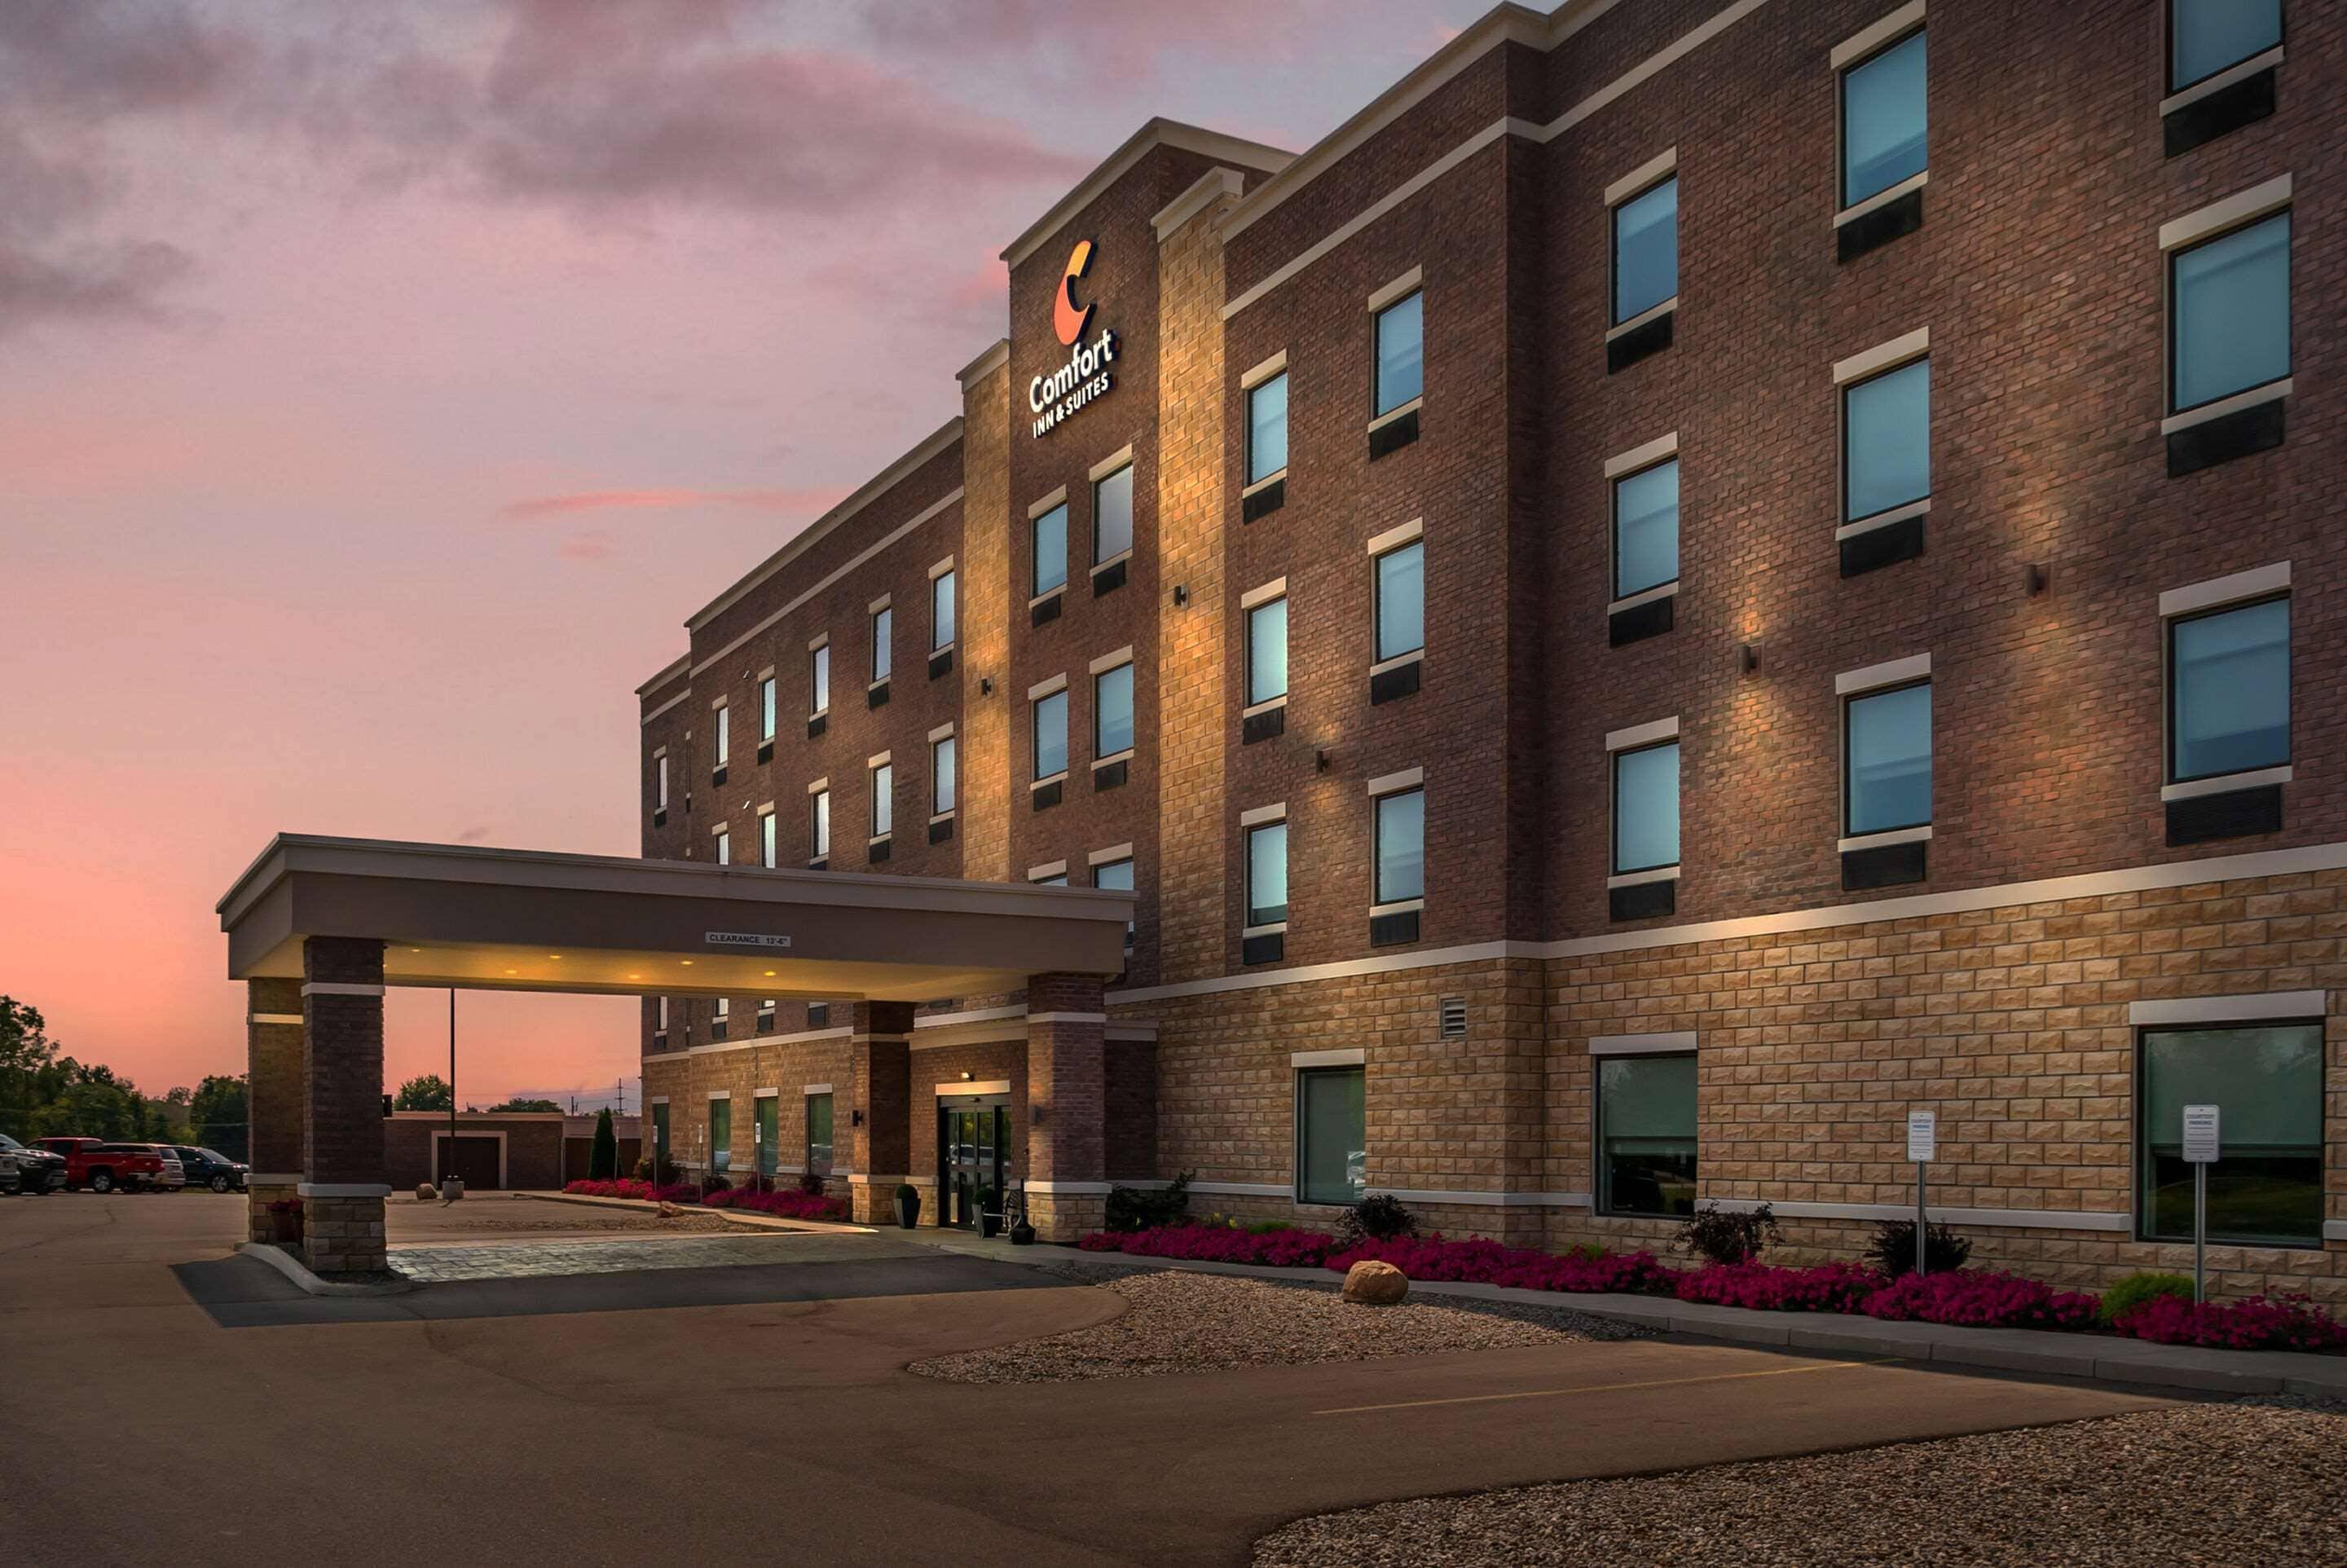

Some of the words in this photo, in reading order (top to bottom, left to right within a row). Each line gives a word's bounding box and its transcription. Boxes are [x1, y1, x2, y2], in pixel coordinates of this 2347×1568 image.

[1029, 328, 1113, 413] Comfort
[1033, 411, 1055, 438] INN
[1055, 403, 1064, 422] &
[1066, 372, 1109, 416] SUITES
[709, 934, 760, 944] CLEARANCE
